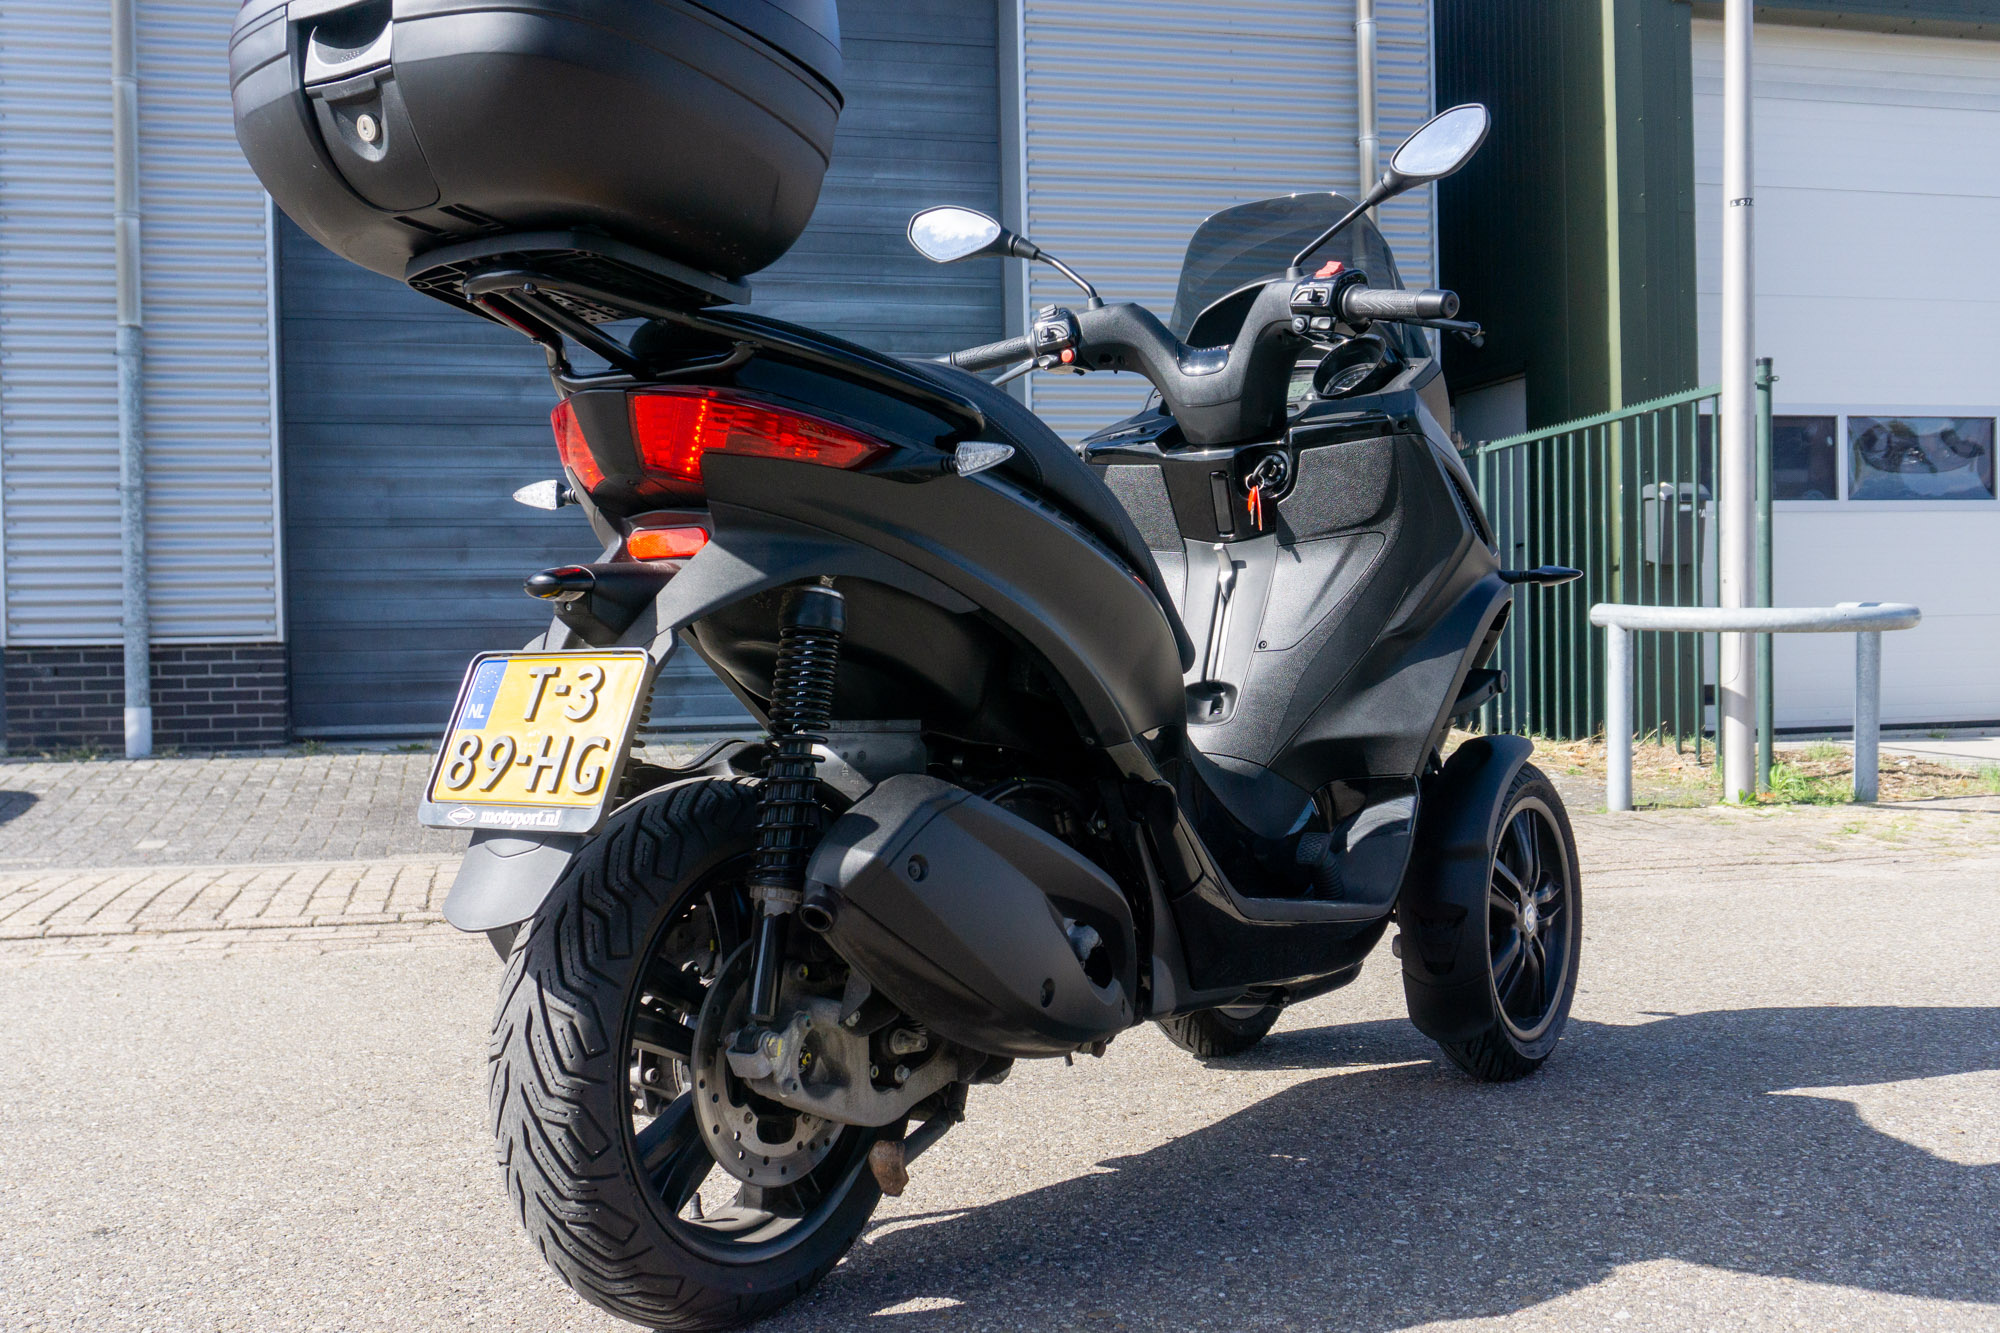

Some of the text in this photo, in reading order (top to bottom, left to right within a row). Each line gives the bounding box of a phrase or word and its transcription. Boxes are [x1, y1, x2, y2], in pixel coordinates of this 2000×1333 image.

[467, 703, 485, 719] NL
[524, 664, 605, 722] T-3
[445, 735, 610, 794] 89-HG
[480, 810, 561, 828] motoport.nl
